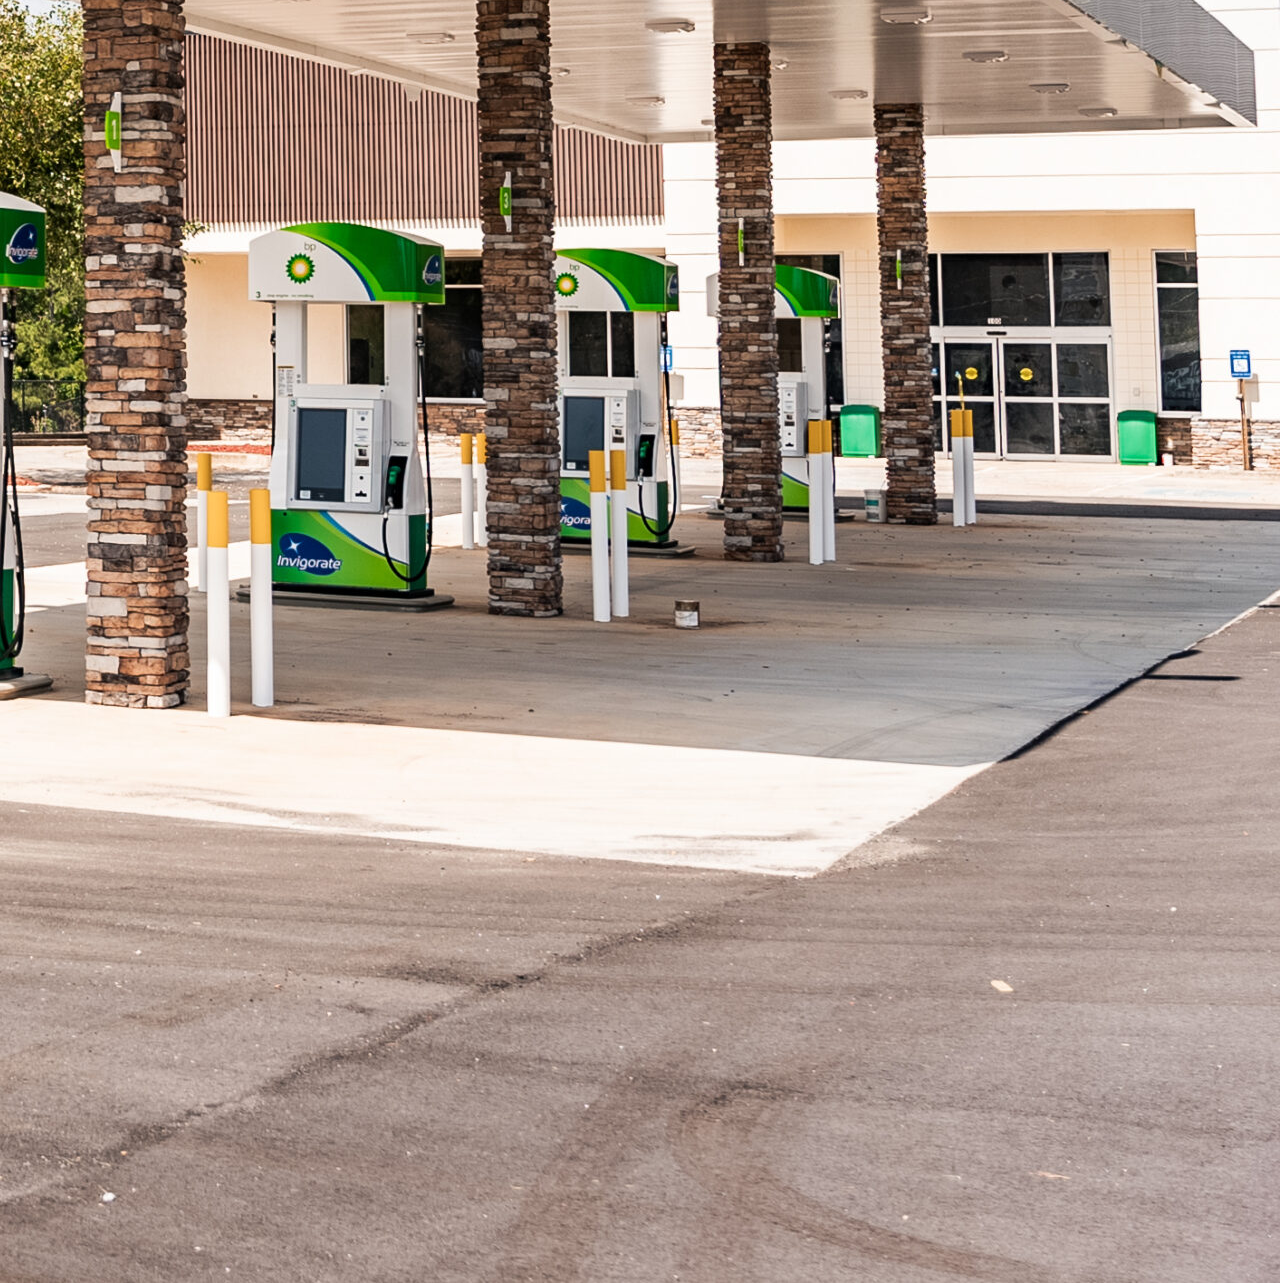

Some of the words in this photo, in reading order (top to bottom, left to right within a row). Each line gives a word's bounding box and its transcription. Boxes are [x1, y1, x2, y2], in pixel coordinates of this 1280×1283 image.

[112, 119, 117, 140] 1
[503, 192, 509, 209] 3
[304, 242, 317, 252] bp
[277, 555, 341, 571] Invigorate
